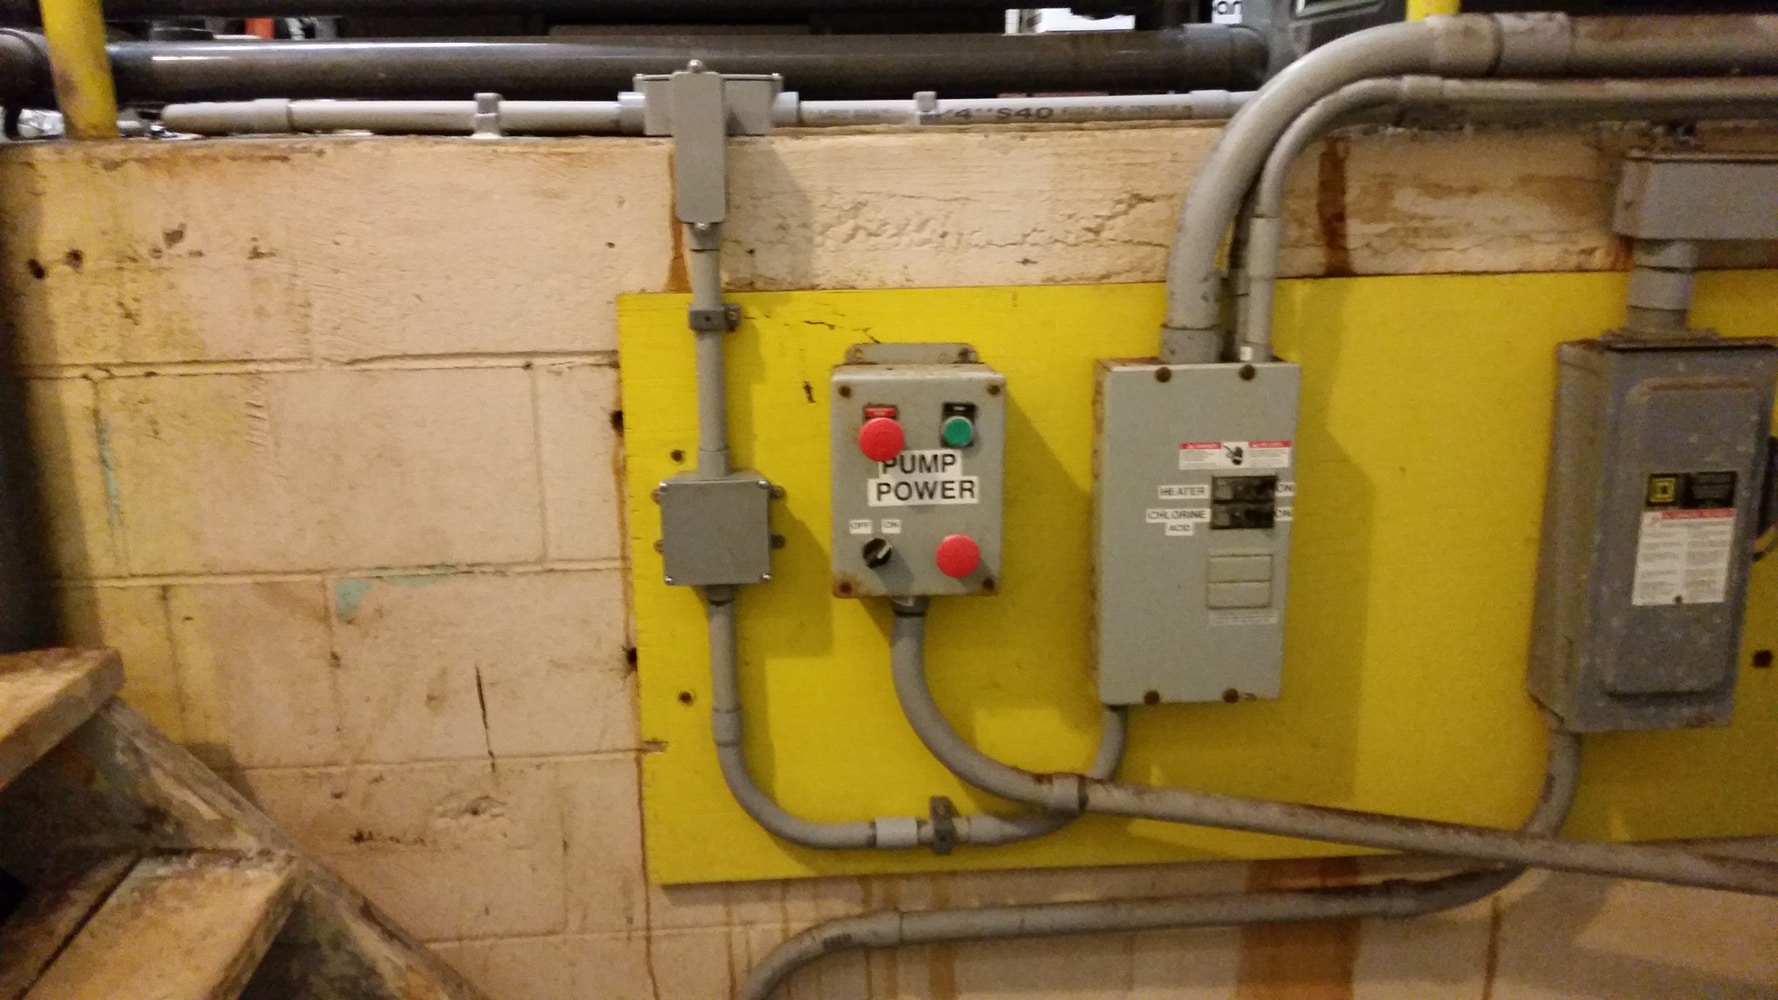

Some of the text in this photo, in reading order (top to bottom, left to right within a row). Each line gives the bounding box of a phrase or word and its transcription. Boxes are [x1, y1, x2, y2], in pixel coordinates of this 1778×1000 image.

[996, 106, 1054, 120] S40
[882, 453, 957, 475] PUMP
[876, 480, 976, 502] POWER
[1159, 486, 1206, 497] HEATER
[1147, 510, 1206, 520] CHLORINE
[882, 521, 900, 529] ON
